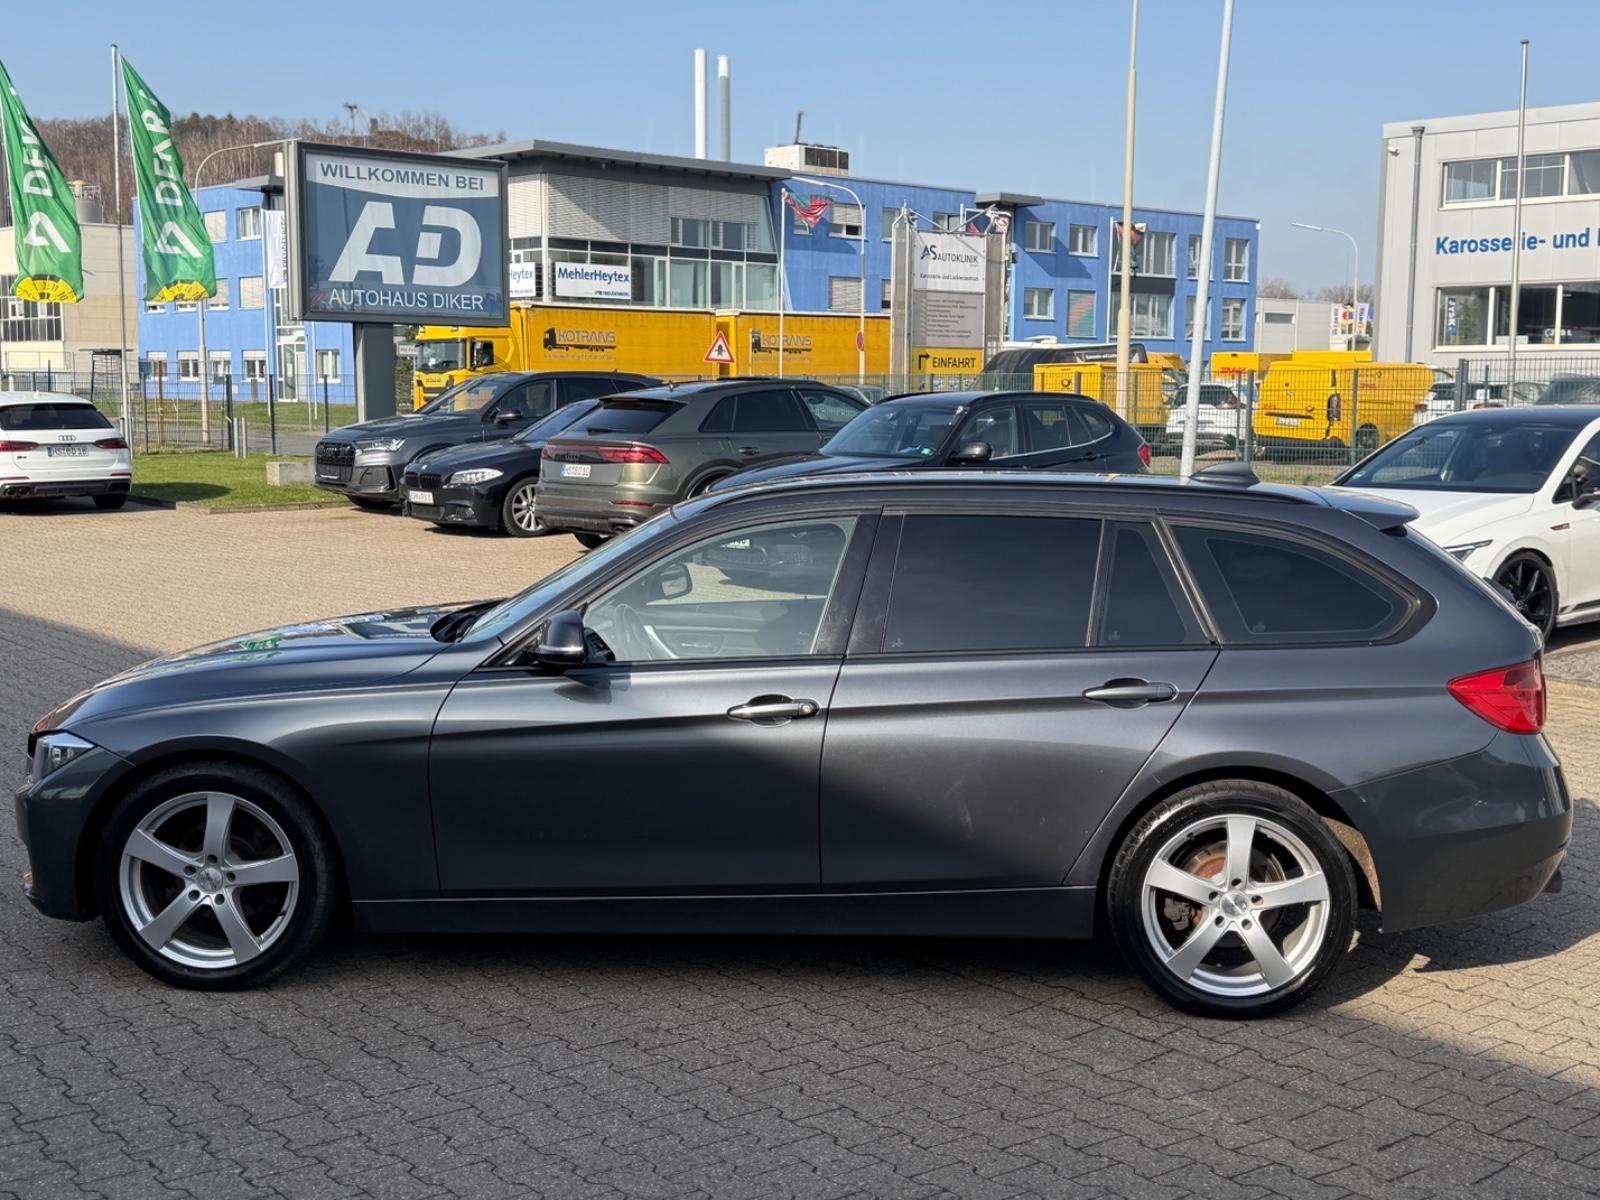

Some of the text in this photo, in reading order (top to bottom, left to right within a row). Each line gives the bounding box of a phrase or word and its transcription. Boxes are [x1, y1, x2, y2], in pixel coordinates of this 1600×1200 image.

[320, 162, 484, 191] WILLKOMMEN BEI
[328, 201, 482, 287] AD
[1436, 232, 1546, 255] Karosseie-
[1553, 228, 1590, 249] und
[920, 244, 979, 263] AS AUTOKLINIK
[557, 267, 629, 285] MehlerHeytex
[328, 288, 484, 310] AUTOHAUS DIKER
[558, 329, 616, 343] KOTRANS
[932, 357, 976, 369] EINFAHRT
